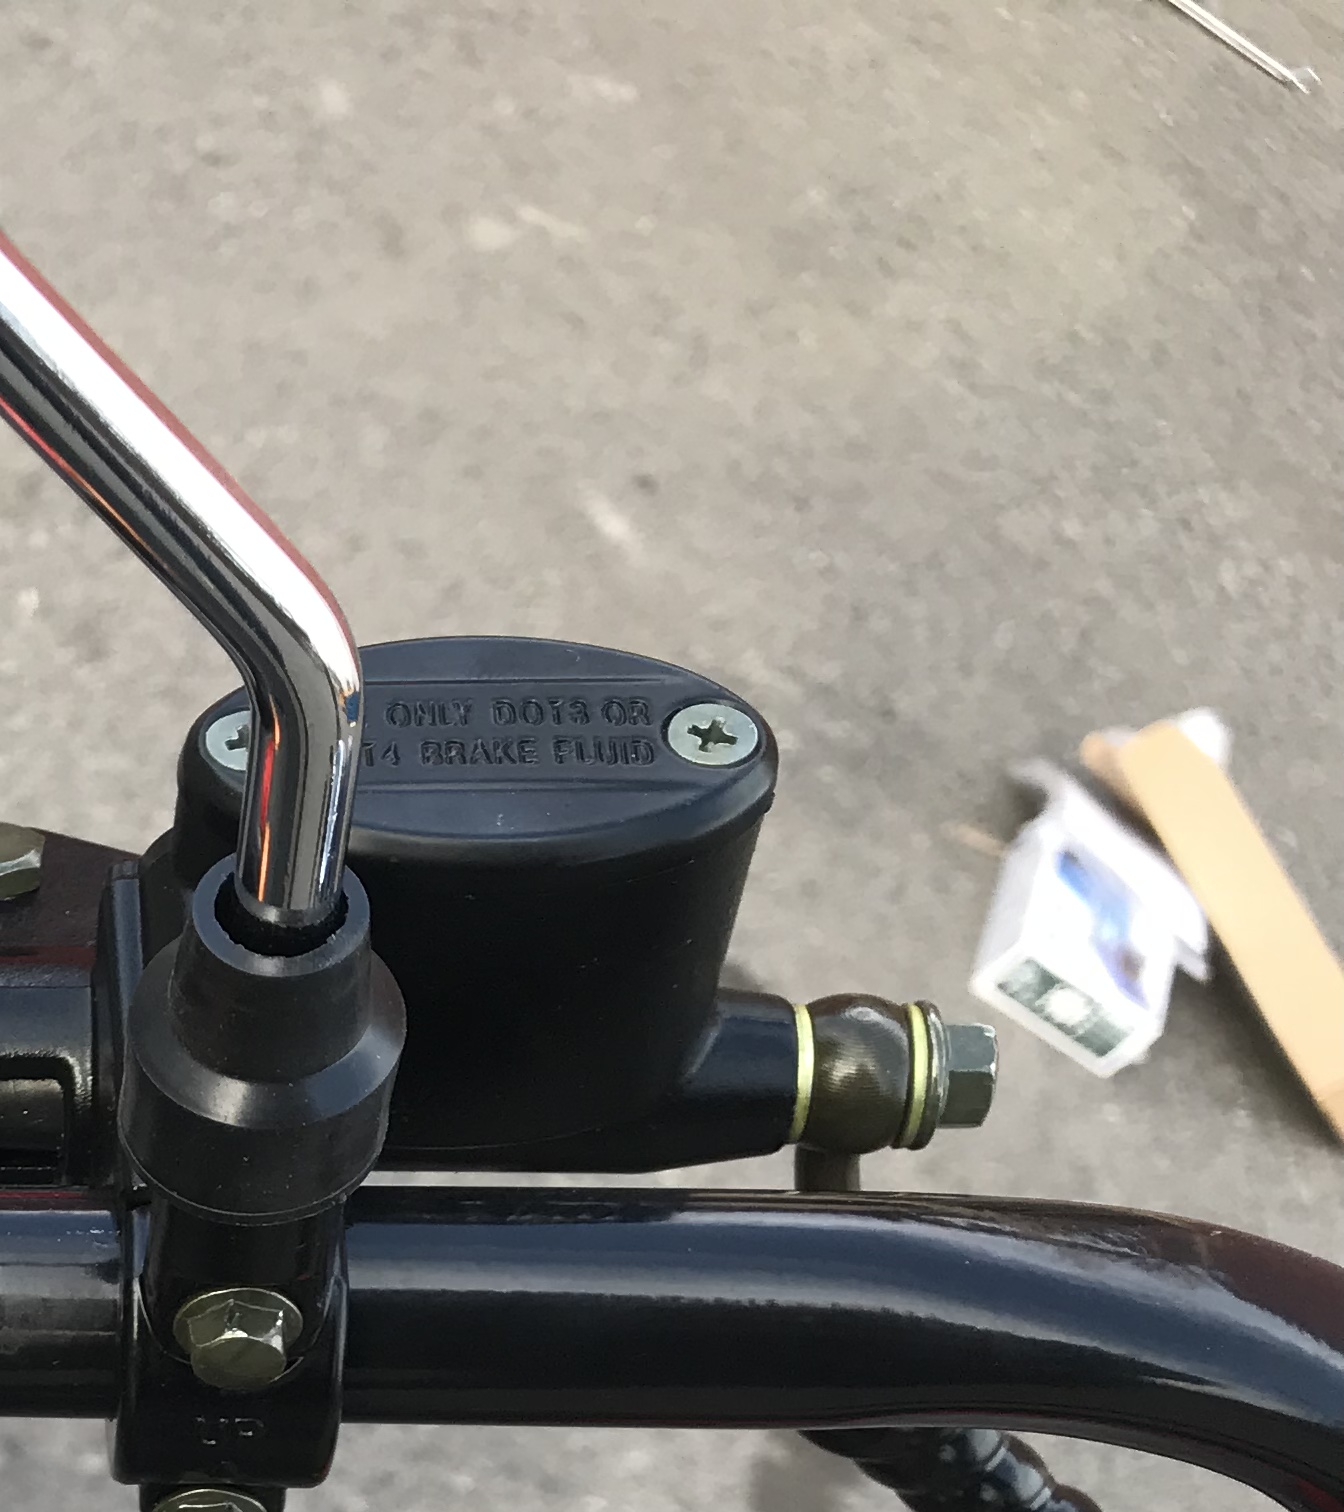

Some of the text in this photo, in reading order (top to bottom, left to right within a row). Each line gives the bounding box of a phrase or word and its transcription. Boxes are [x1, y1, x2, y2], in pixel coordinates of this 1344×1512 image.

[384, 696, 653, 727] ONLY DOT3 OR
[362, 735, 656, 767] T4 BRAKE FLUID
